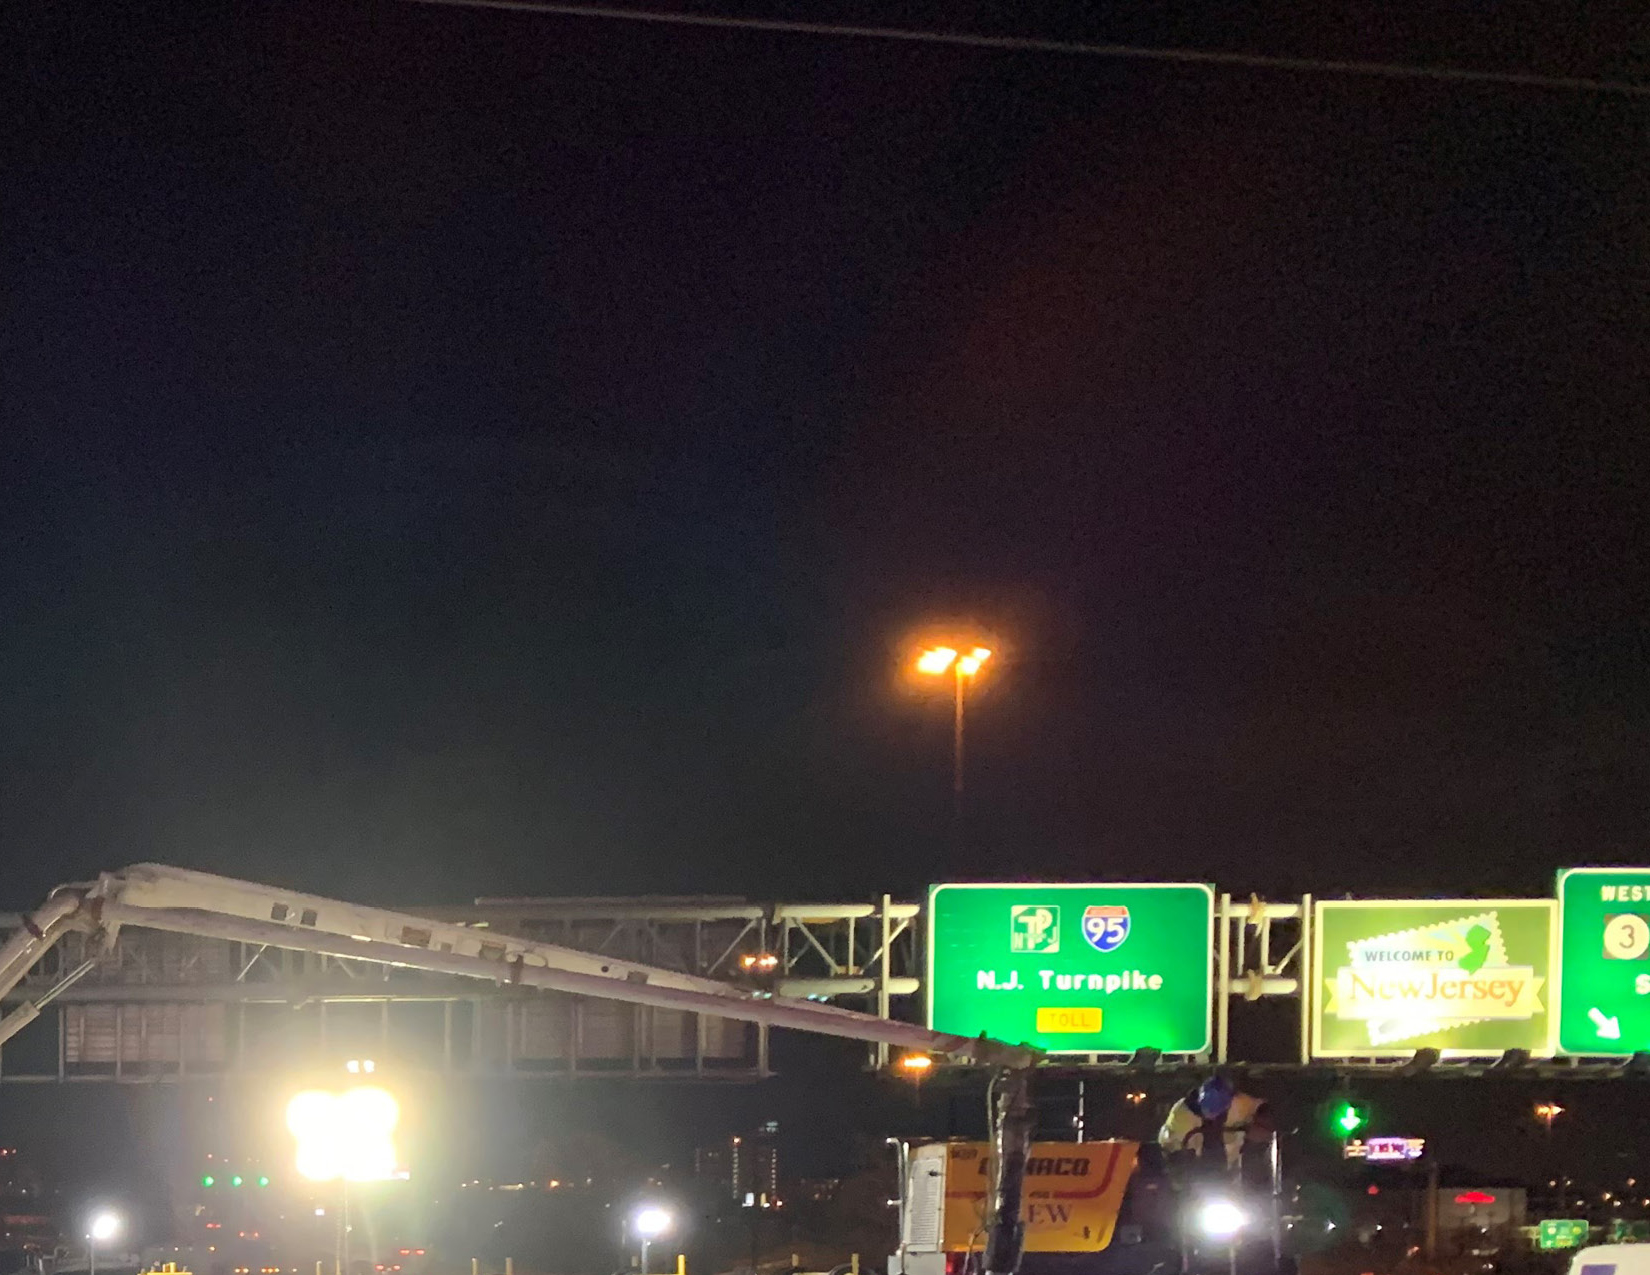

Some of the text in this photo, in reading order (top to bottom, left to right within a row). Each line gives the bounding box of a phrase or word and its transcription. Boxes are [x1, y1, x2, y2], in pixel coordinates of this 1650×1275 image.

[1087, 917, 1125, 944] 95
[1619, 924, 1635, 949] 3
[1365, 950, 1454, 962] WELCOME TO
[977, 970, 1163, 994] N.J. Turnpike
[1050, 1013, 1091, 1028] TOLL
